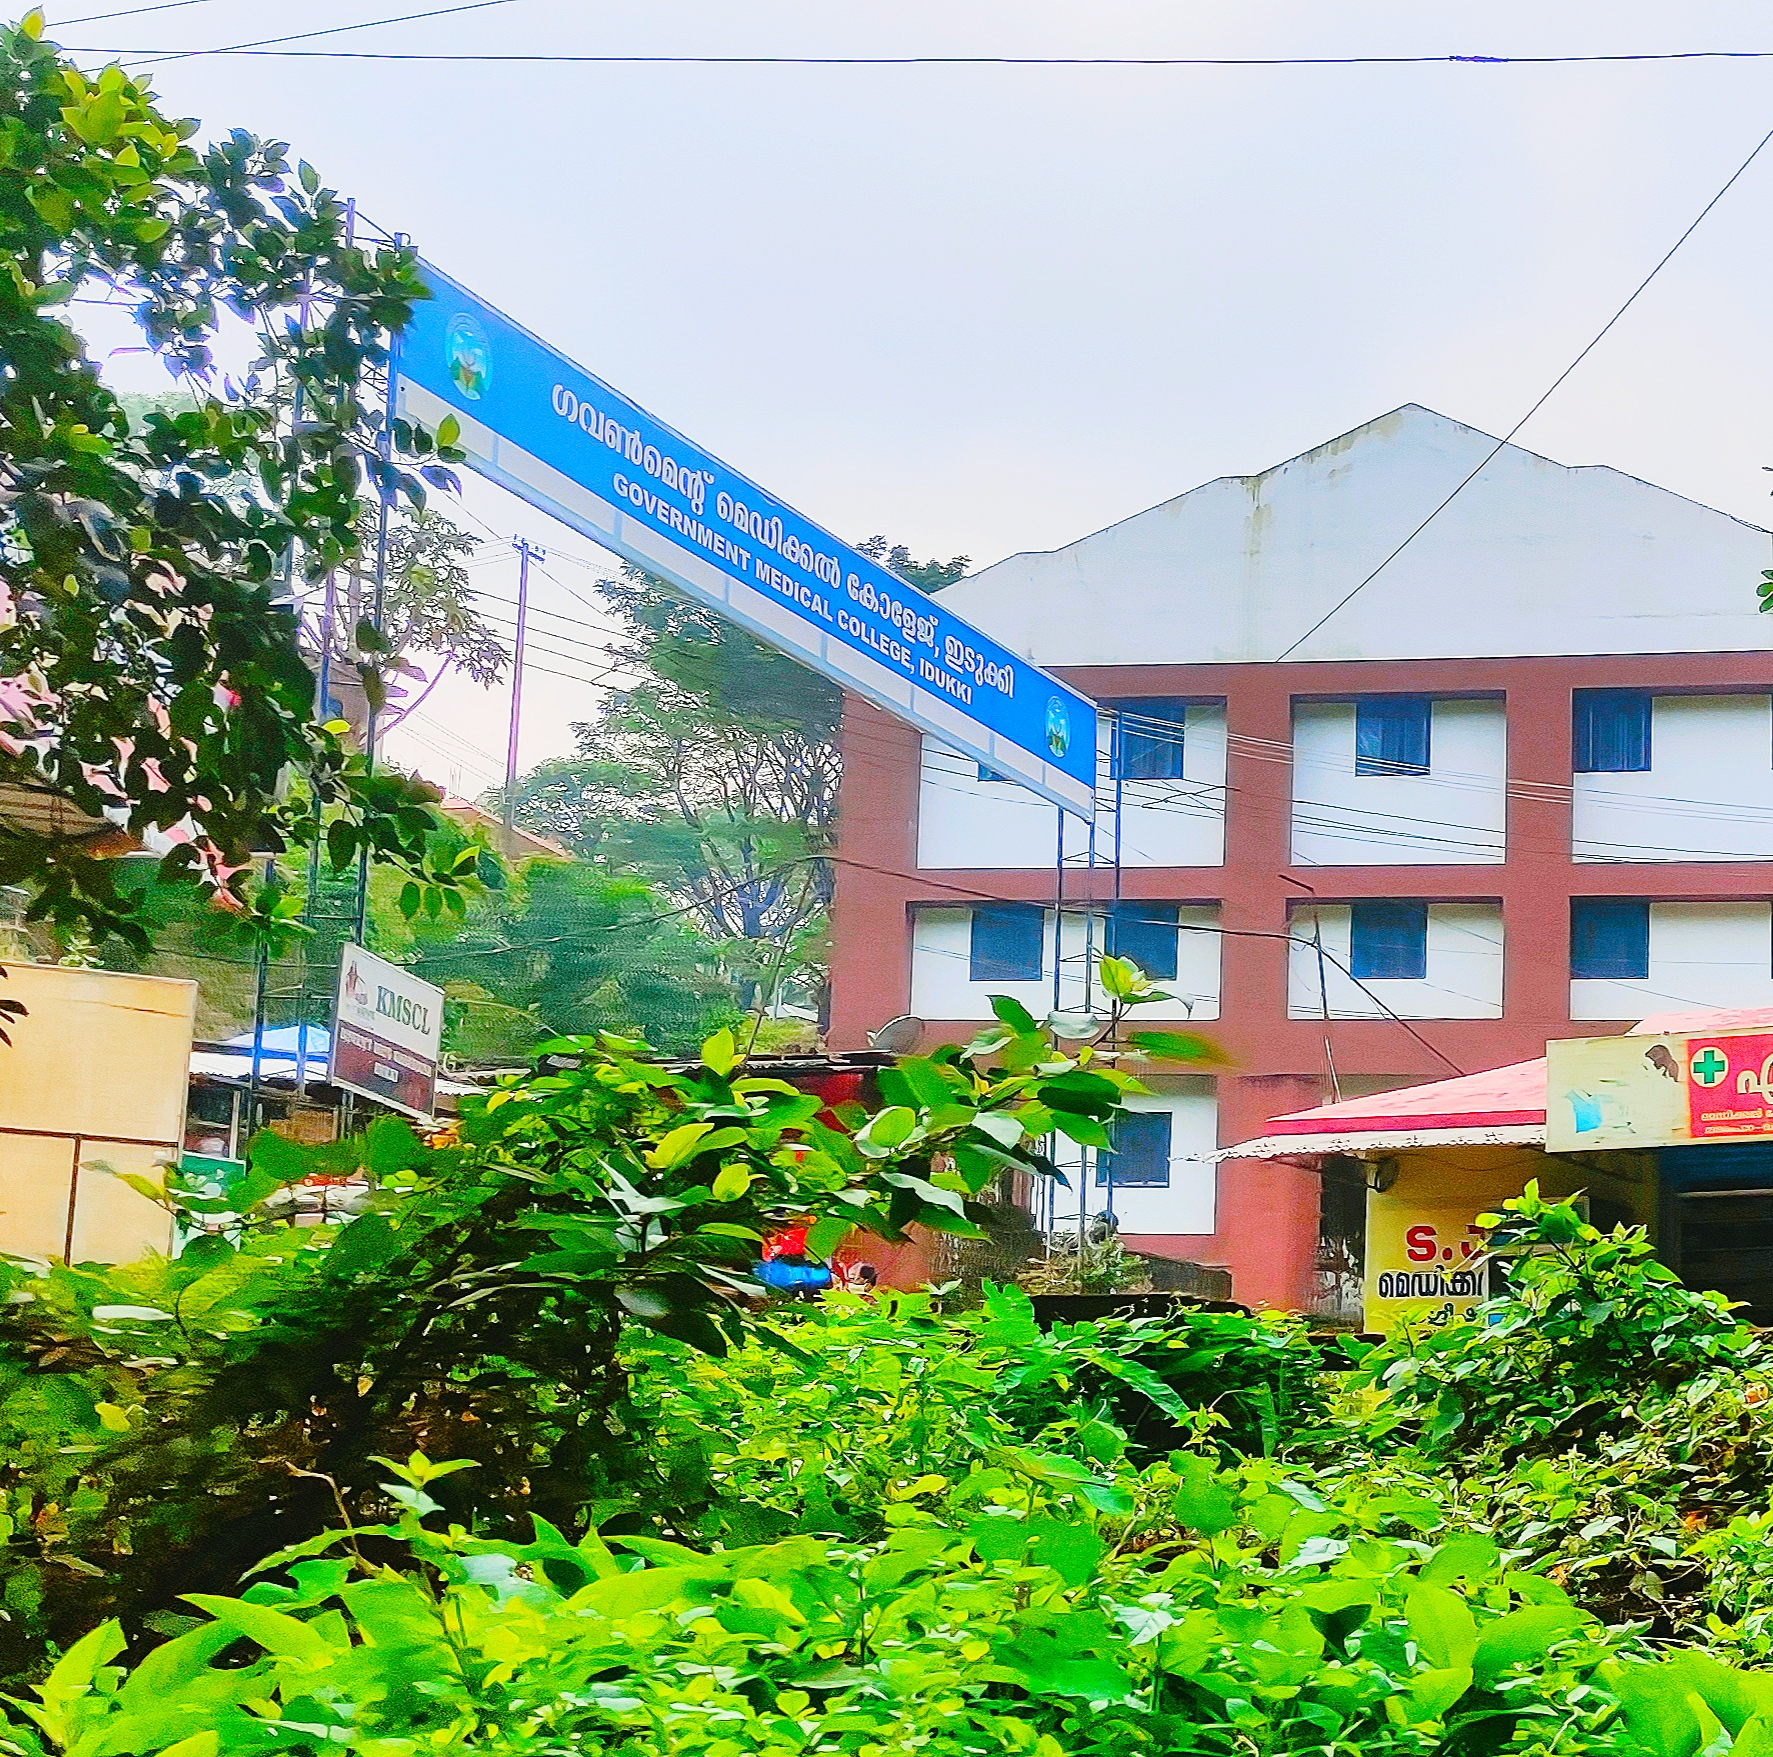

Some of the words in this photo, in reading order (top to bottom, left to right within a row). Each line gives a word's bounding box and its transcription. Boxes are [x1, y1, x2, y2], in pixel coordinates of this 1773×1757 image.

[613, 472, 751, 570] GOVERNMENT
[756, 557, 833, 623] MEDICAL
[838, 609, 915, 674] COLLEGE,
[920, 658, 972, 705] IDUKKI
[717, 492, 841, 589] മെഡിക്കൽ
[847, 573, 939, 658] കോളേജ്,
[945, 636, 1014, 698] ഇടുക്കി
[376, 985, 431, 1035] KMSCL
[1379, 1264, 1483, 1298] മെഡിക്ക
